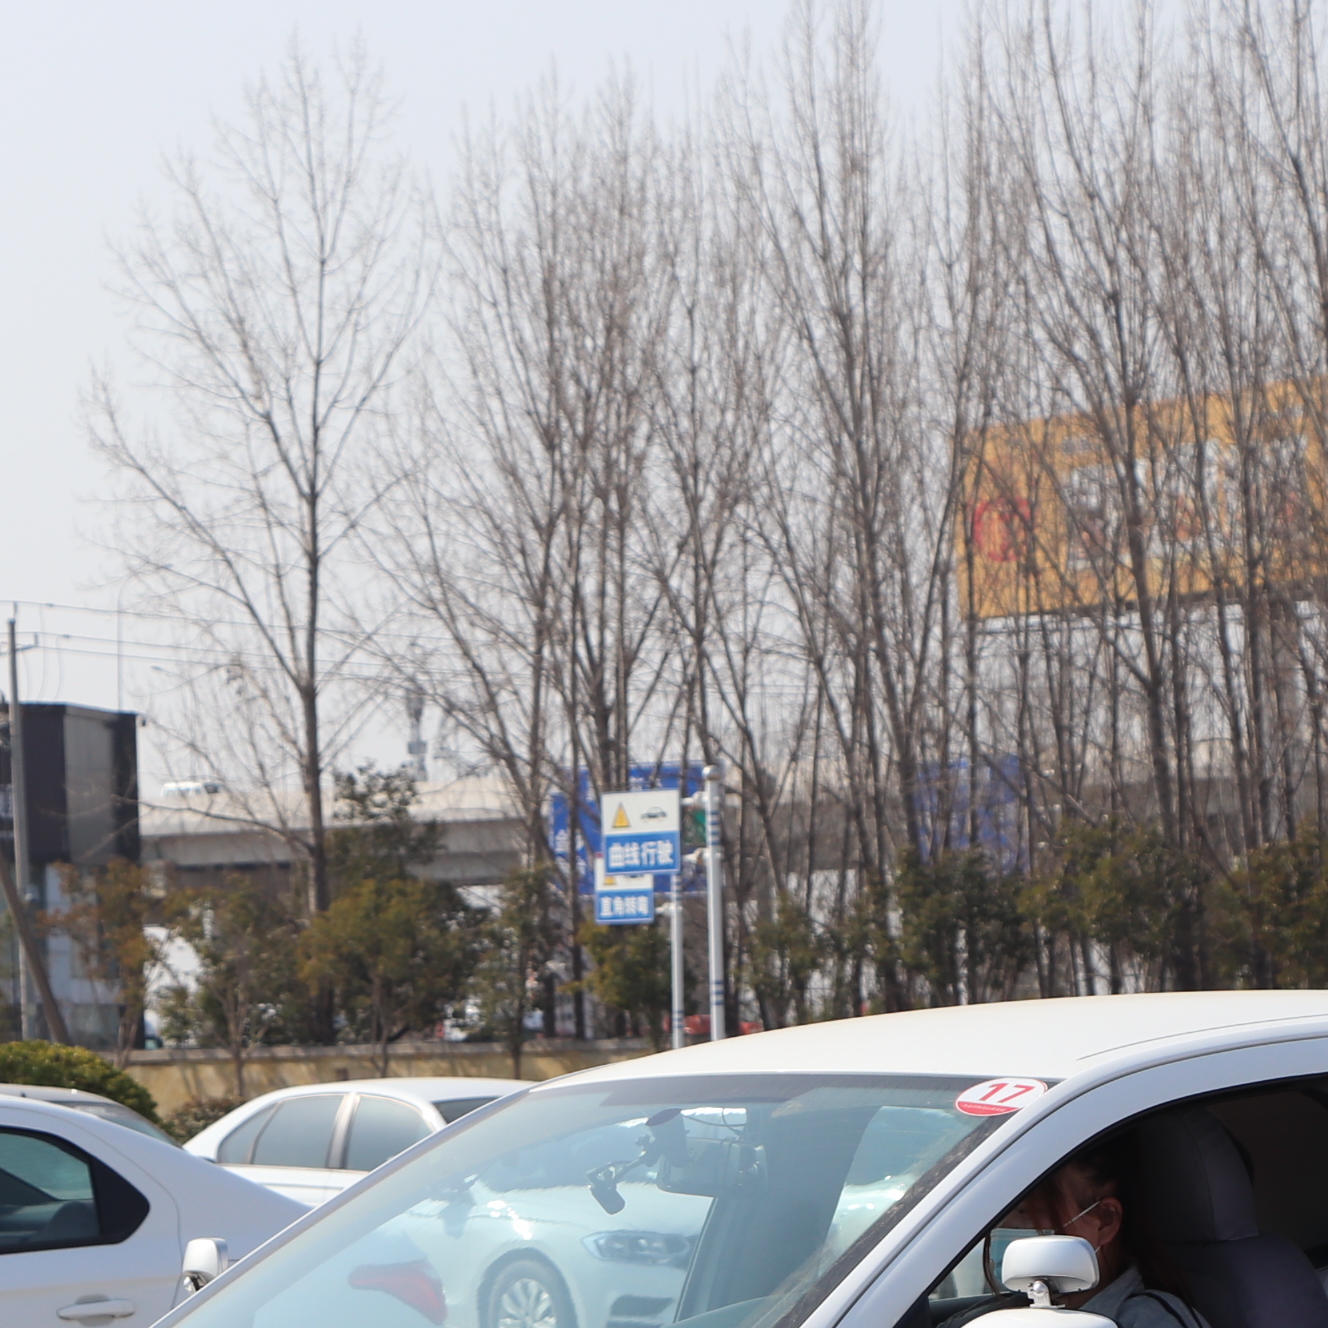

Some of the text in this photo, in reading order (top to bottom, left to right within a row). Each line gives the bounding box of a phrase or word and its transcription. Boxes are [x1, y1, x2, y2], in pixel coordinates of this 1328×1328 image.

[608, 839, 674, 868] 曲线行驶
[979, 1082, 1035, 1103] 17
